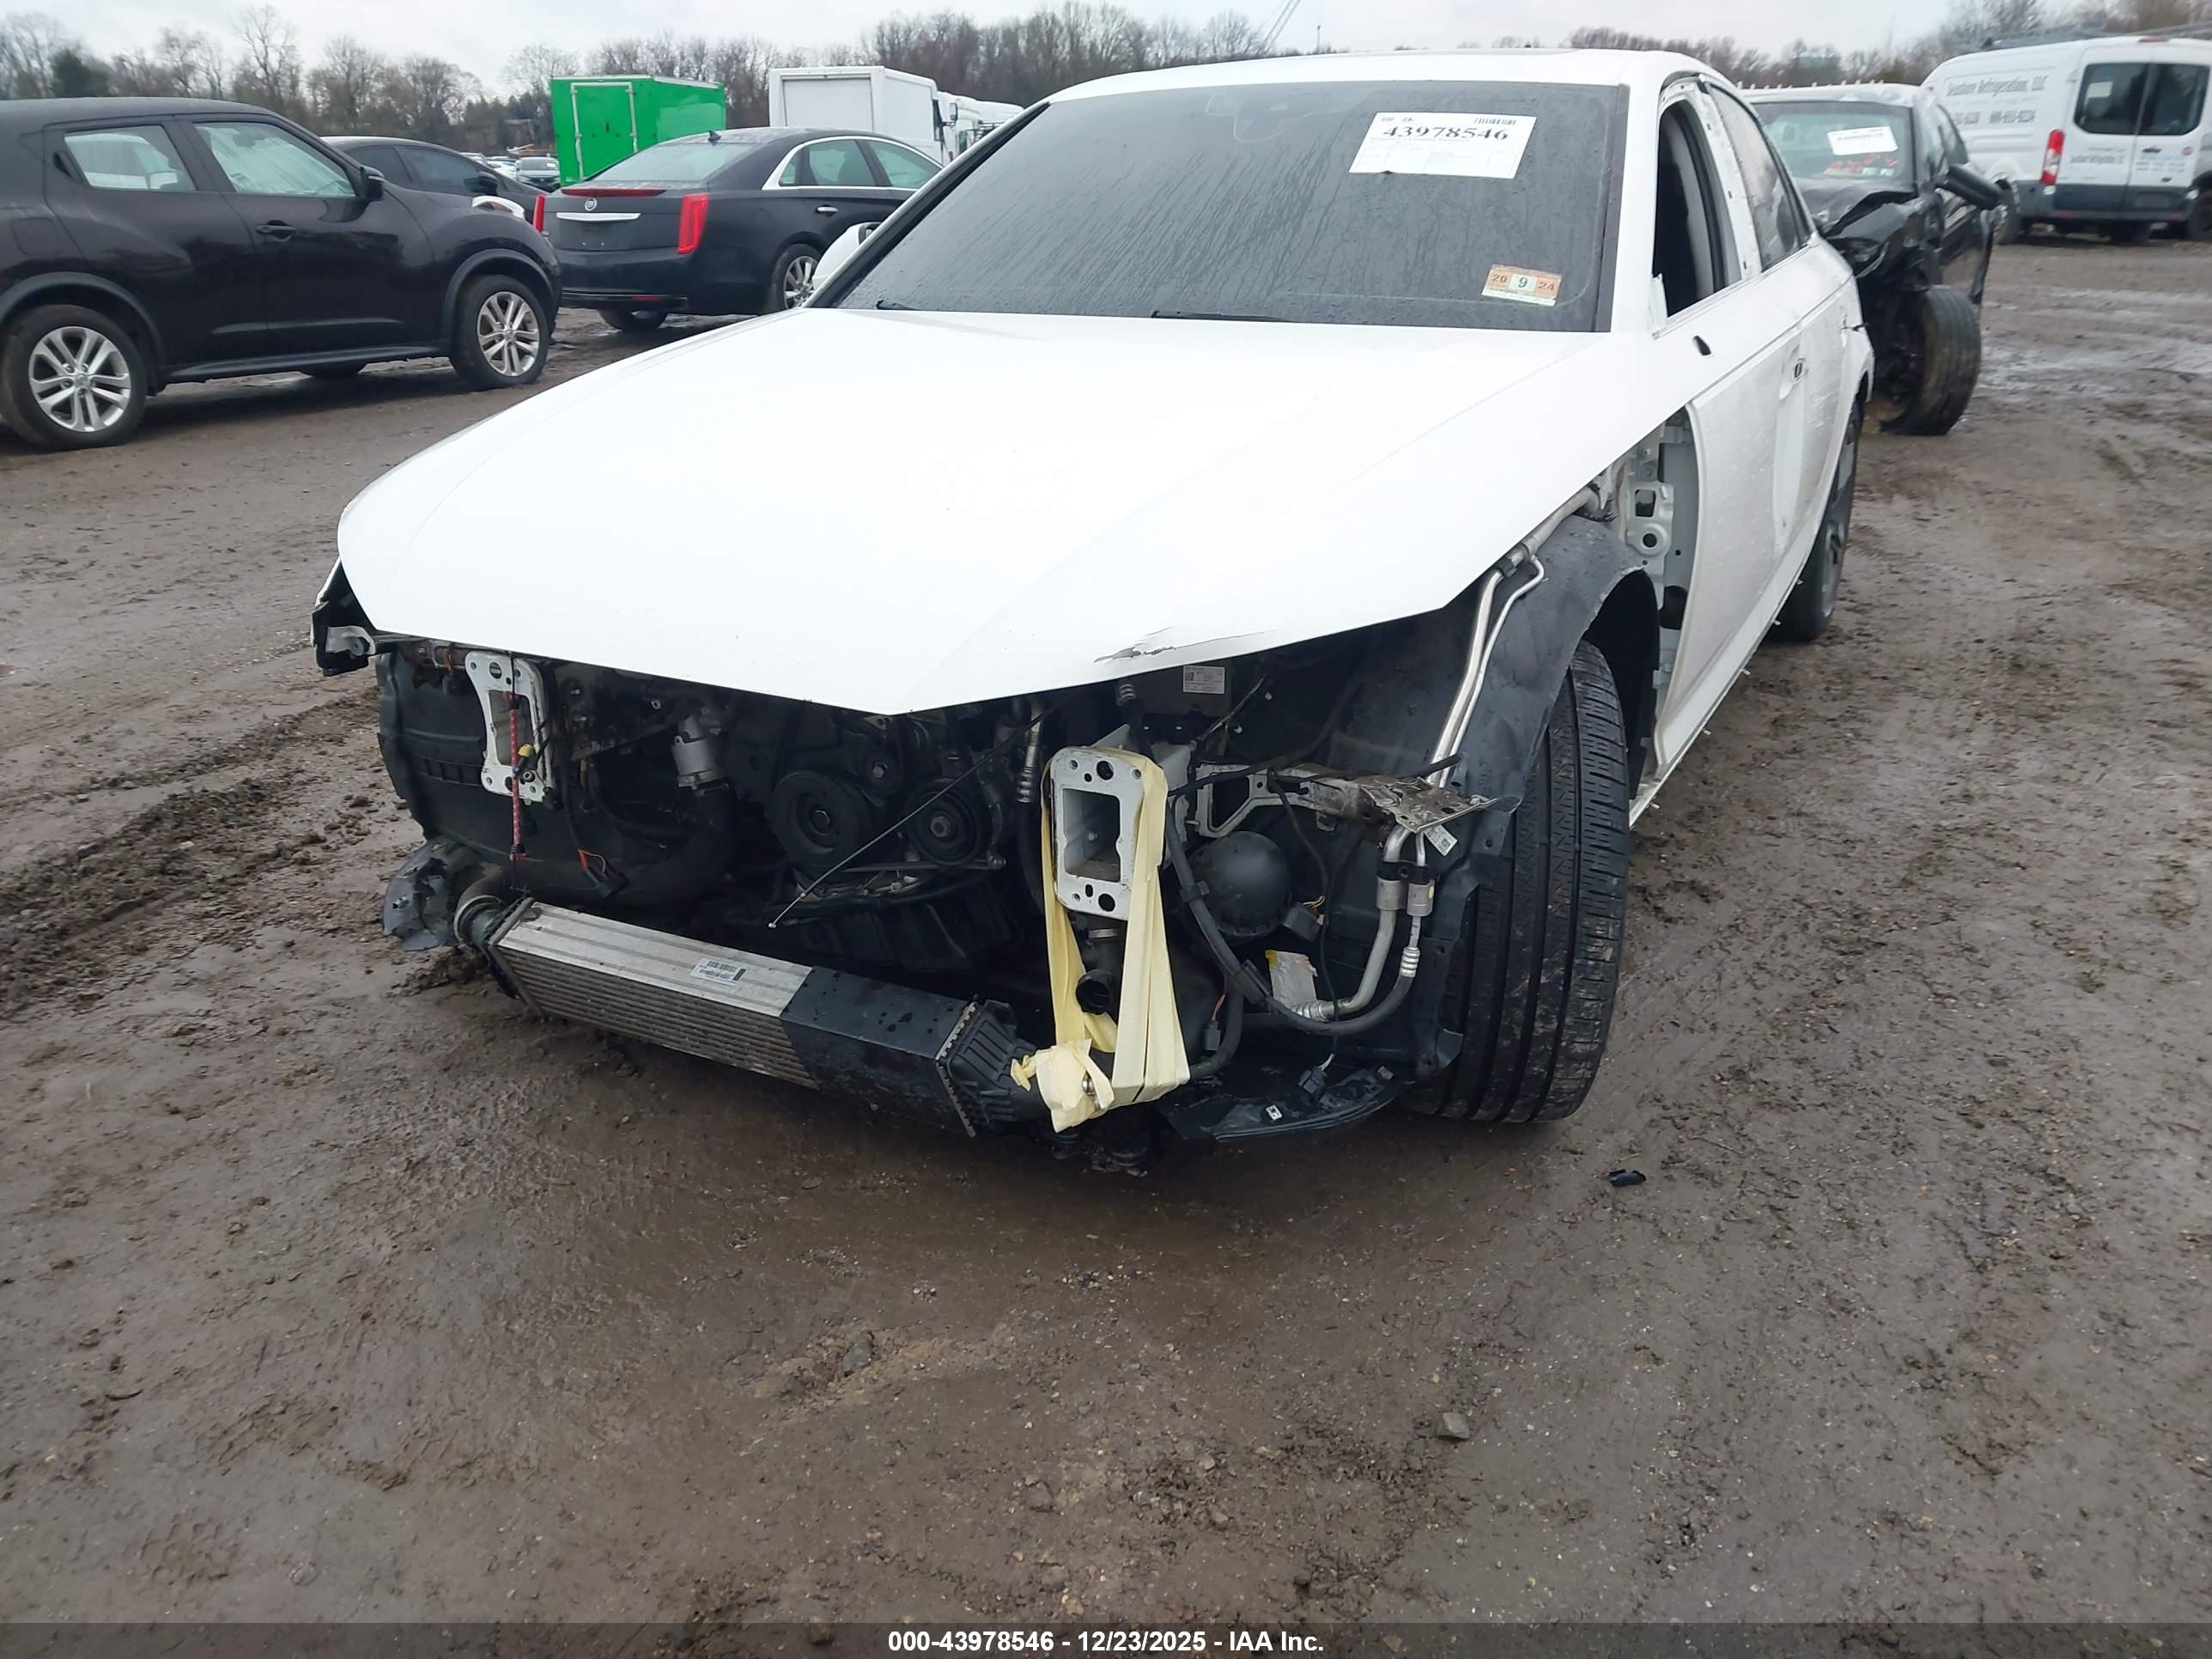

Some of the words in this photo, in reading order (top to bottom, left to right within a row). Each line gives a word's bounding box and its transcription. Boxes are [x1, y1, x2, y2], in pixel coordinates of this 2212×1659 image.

[1382, 125, 1510, 141] 43978546
[1492, 273, 1508, 283] 20
[1517, 276, 1528, 289] 9
[1538, 281, 1555, 291] 24
